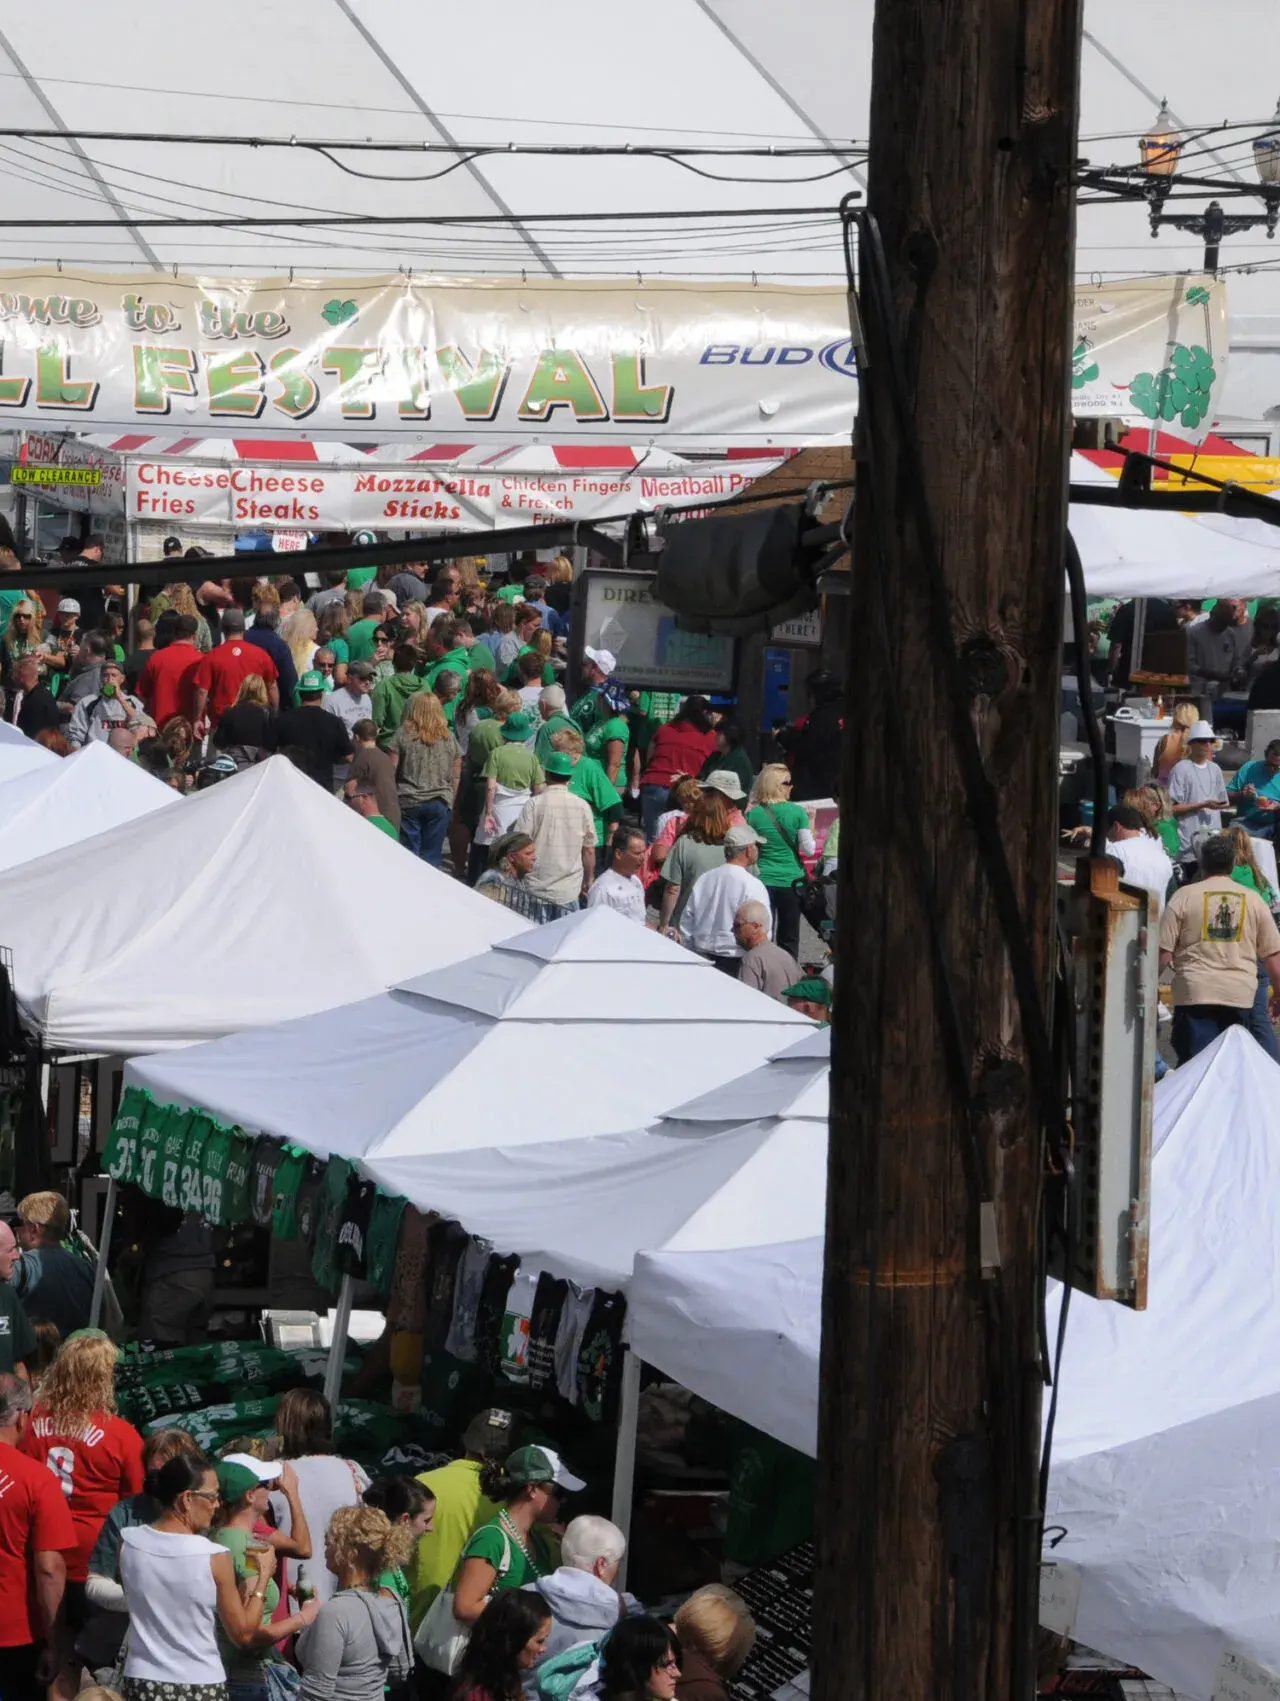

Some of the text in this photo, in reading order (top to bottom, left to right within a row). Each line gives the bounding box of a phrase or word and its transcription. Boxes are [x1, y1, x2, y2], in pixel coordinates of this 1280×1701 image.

[122, 293, 180, 334] to
[200, 298, 291, 342] the
[699, 343, 814, 368] BUD
[131, 339, 676, 425] FESTIVAL
[15, 470, 97, 483] LOW CLEARANCE
[137, 463, 229, 489] Cheese
[230, 469, 324, 493] Cheese
[354, 473, 491, 498] Mozzarella
[500, 475, 632, 496] Chicken Fingers
[640, 474, 723, 498] Meatball
[136, 490, 195, 514] Fries
[235, 497, 320, 520] Steaks
[383, 499, 461, 520] Sticks
[500, 494, 574, 510] & French
[278, 539, 301, 552] HERE
